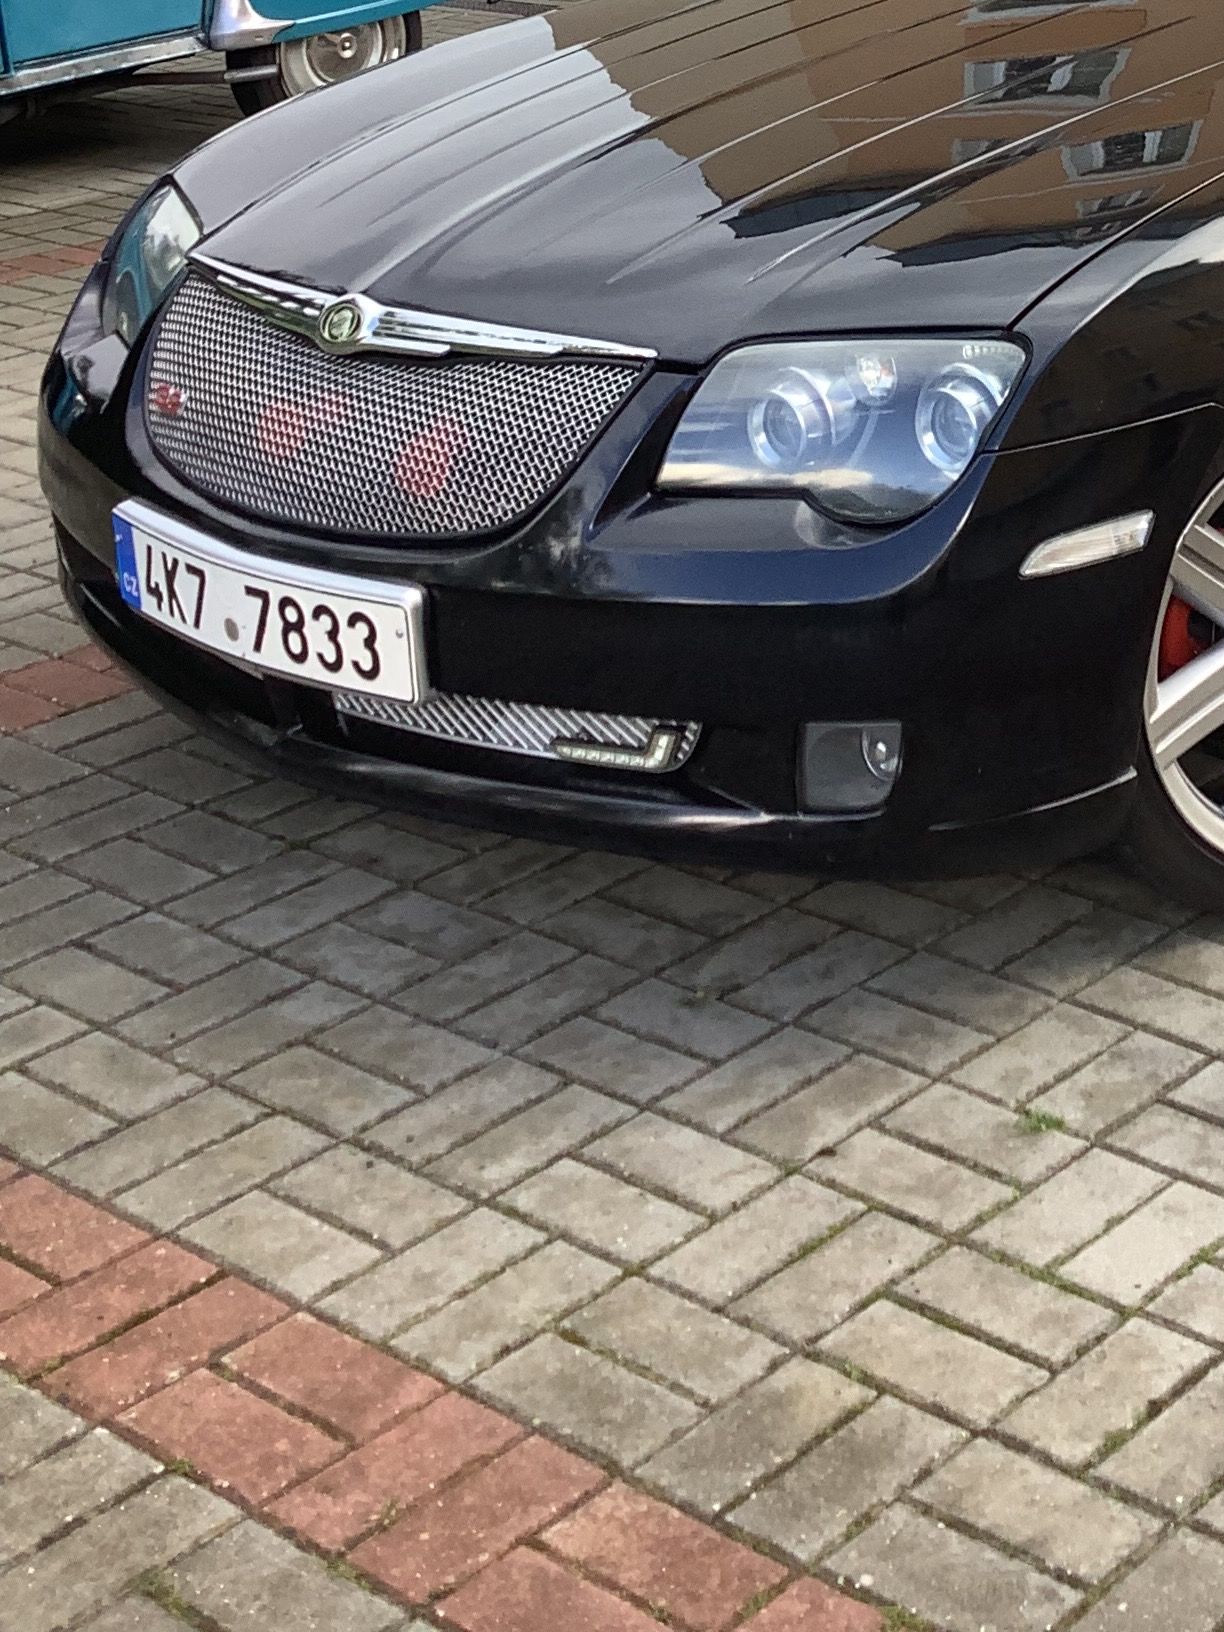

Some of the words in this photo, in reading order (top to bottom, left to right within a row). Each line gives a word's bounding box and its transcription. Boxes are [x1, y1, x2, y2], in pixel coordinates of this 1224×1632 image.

[123, 571, 139, 597] CZ
[145, 545, 206, 629] 4K7
[244, 585, 381, 681] 7833
